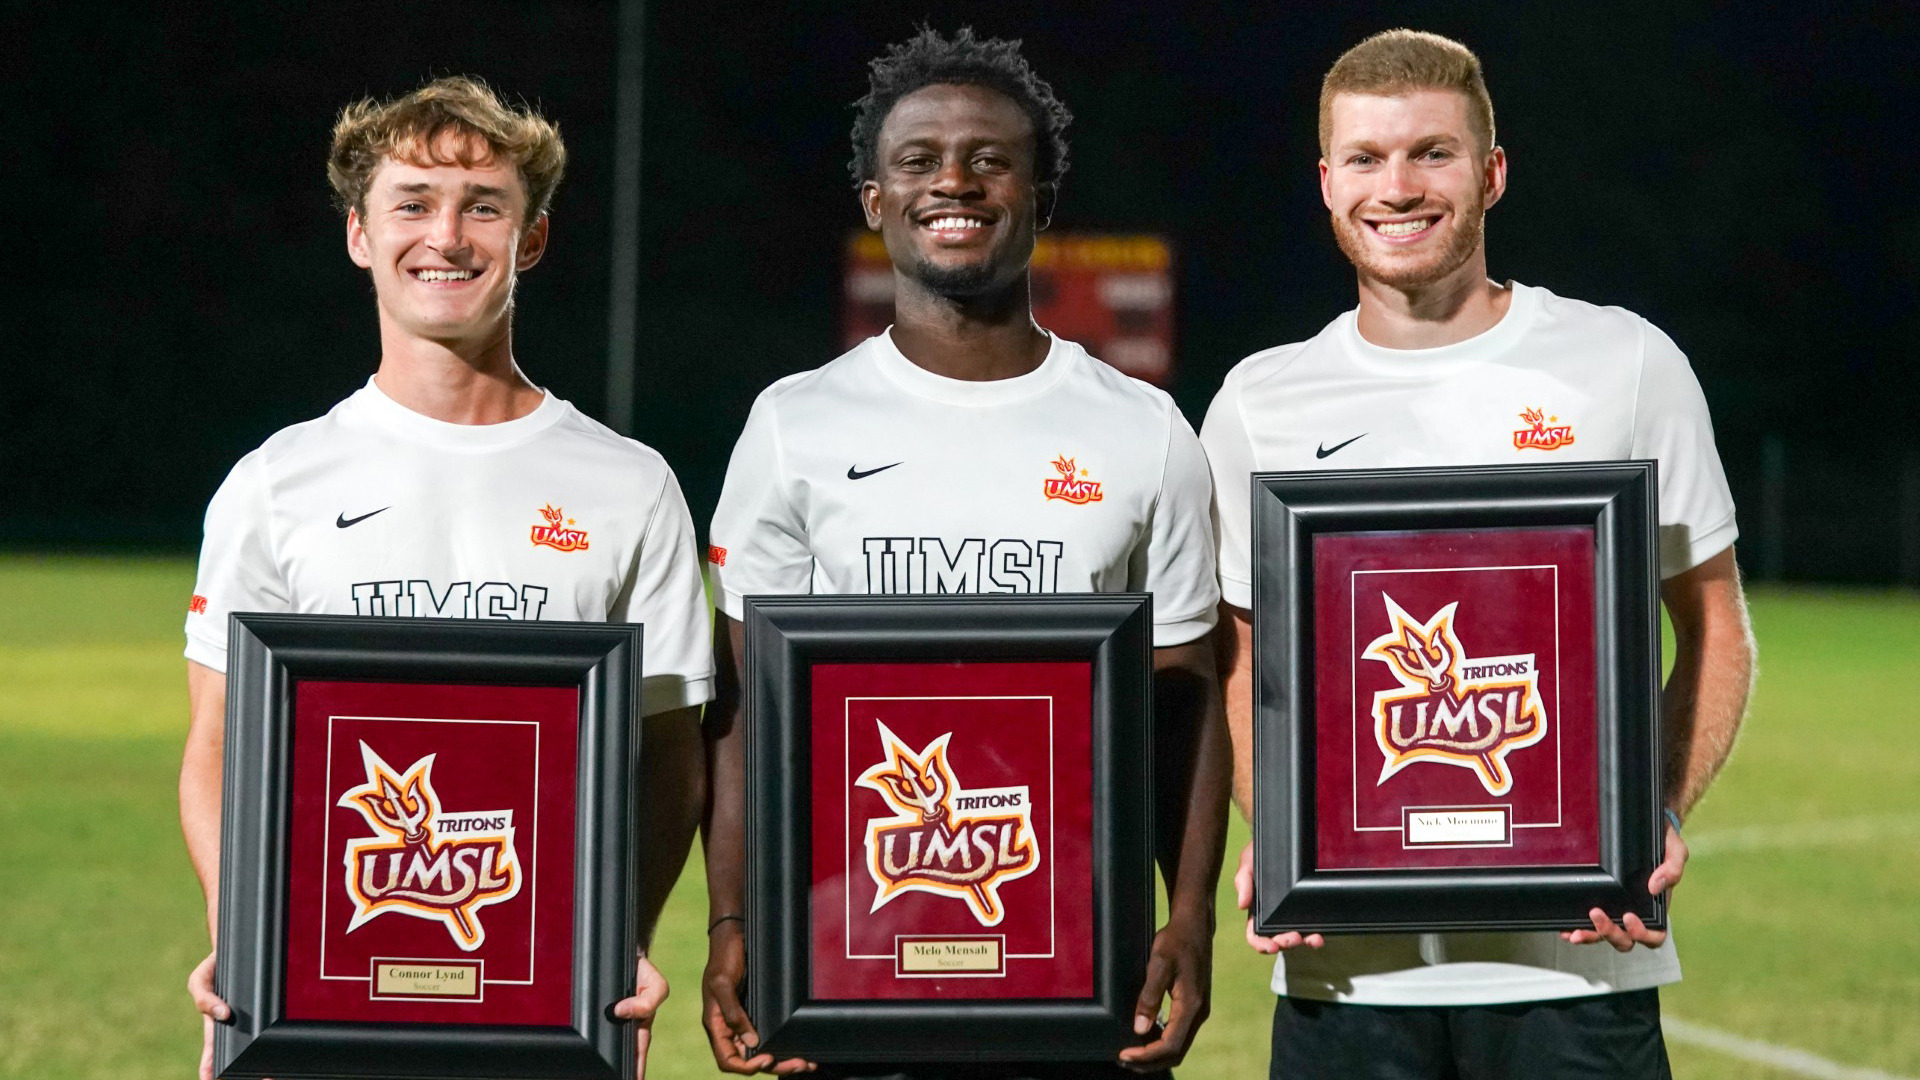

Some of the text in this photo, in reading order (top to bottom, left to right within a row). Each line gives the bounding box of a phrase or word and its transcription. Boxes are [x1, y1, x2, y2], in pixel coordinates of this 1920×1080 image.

[1514, 427, 1574, 450] UMSL
[1045, 480, 1103, 504] UMSL
[532, 526, 589, 551] UMSL
[1462, 661, 1528, 680] TRITONS
[1391, 690, 1532, 750] UMSL
[955, 793, 1022, 810] TRITONS
[437, 817, 506, 833] TRITONS
[883, 823, 1024, 882] UMSL
[362, 846, 507, 904] UMSL
[914, 945, 988, 955] Melo Mensah
[389, 968, 465, 983] Connor Lynd
